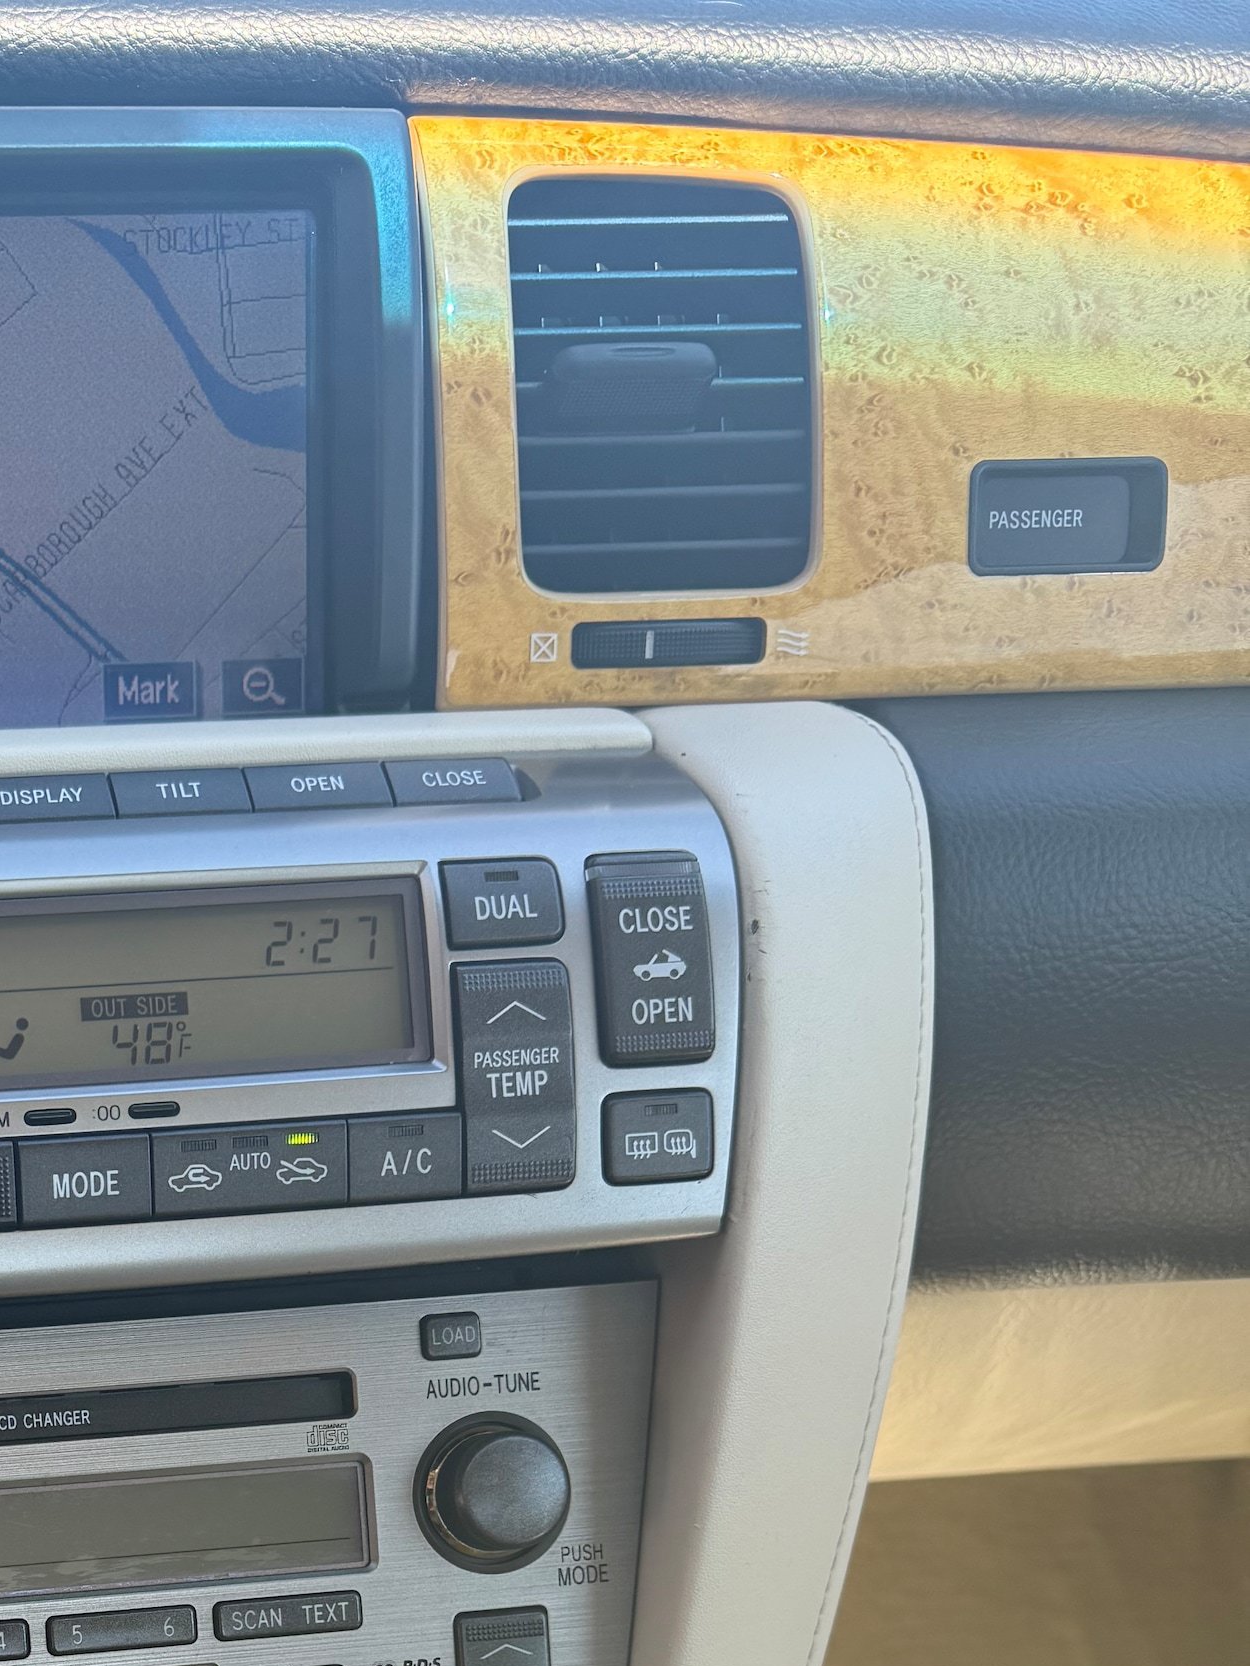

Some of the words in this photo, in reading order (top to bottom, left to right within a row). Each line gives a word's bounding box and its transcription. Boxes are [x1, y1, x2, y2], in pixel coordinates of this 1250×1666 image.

[113, 436, 163, 486] AVE
[158, 386, 209, 442] EXT
[988, 508, 1084, 530] PASSENGER
[118, 675, 180, 708] Mark
[155, 780, 203, 800] TILT
[290, 774, 345, 794] OPEN
[421, 768, 487, 788] CLOSE
[474, 894, 538, 921] DUAL
[617, 907, 694, 934] CLOSE
[264, 914, 379, 969] 2:27
[90, 997, 127, 1018] OUT
[136, 994, 178, 1015] SIDE
[631, 997, 694, 1026] OPEN
[473, 1046, 560, 1070] PASSENGER
[486, 1070, 550, 1099] TEMP
[228, 1150, 272, 1172] AUTO
[380, 1146, 434, 1177] A/C
[52, 1169, 120, 1200] MODE
[431, 1325, 477, 1347] LOAD
[425, 1372, 542, 1400] AUDIO-TUNE
[22, 1408, 91, 1429] CHANGER
[559, 1543, 604, 1564] PUSH
[557, 1562, 609, 1588] MODE
[231, 1608, 283, 1632] SCAN
[301, 1602, 350, 1625] TEXT
[71, 1624, 83, 1646] 5
[162, 1616, 175, 1638] 6
